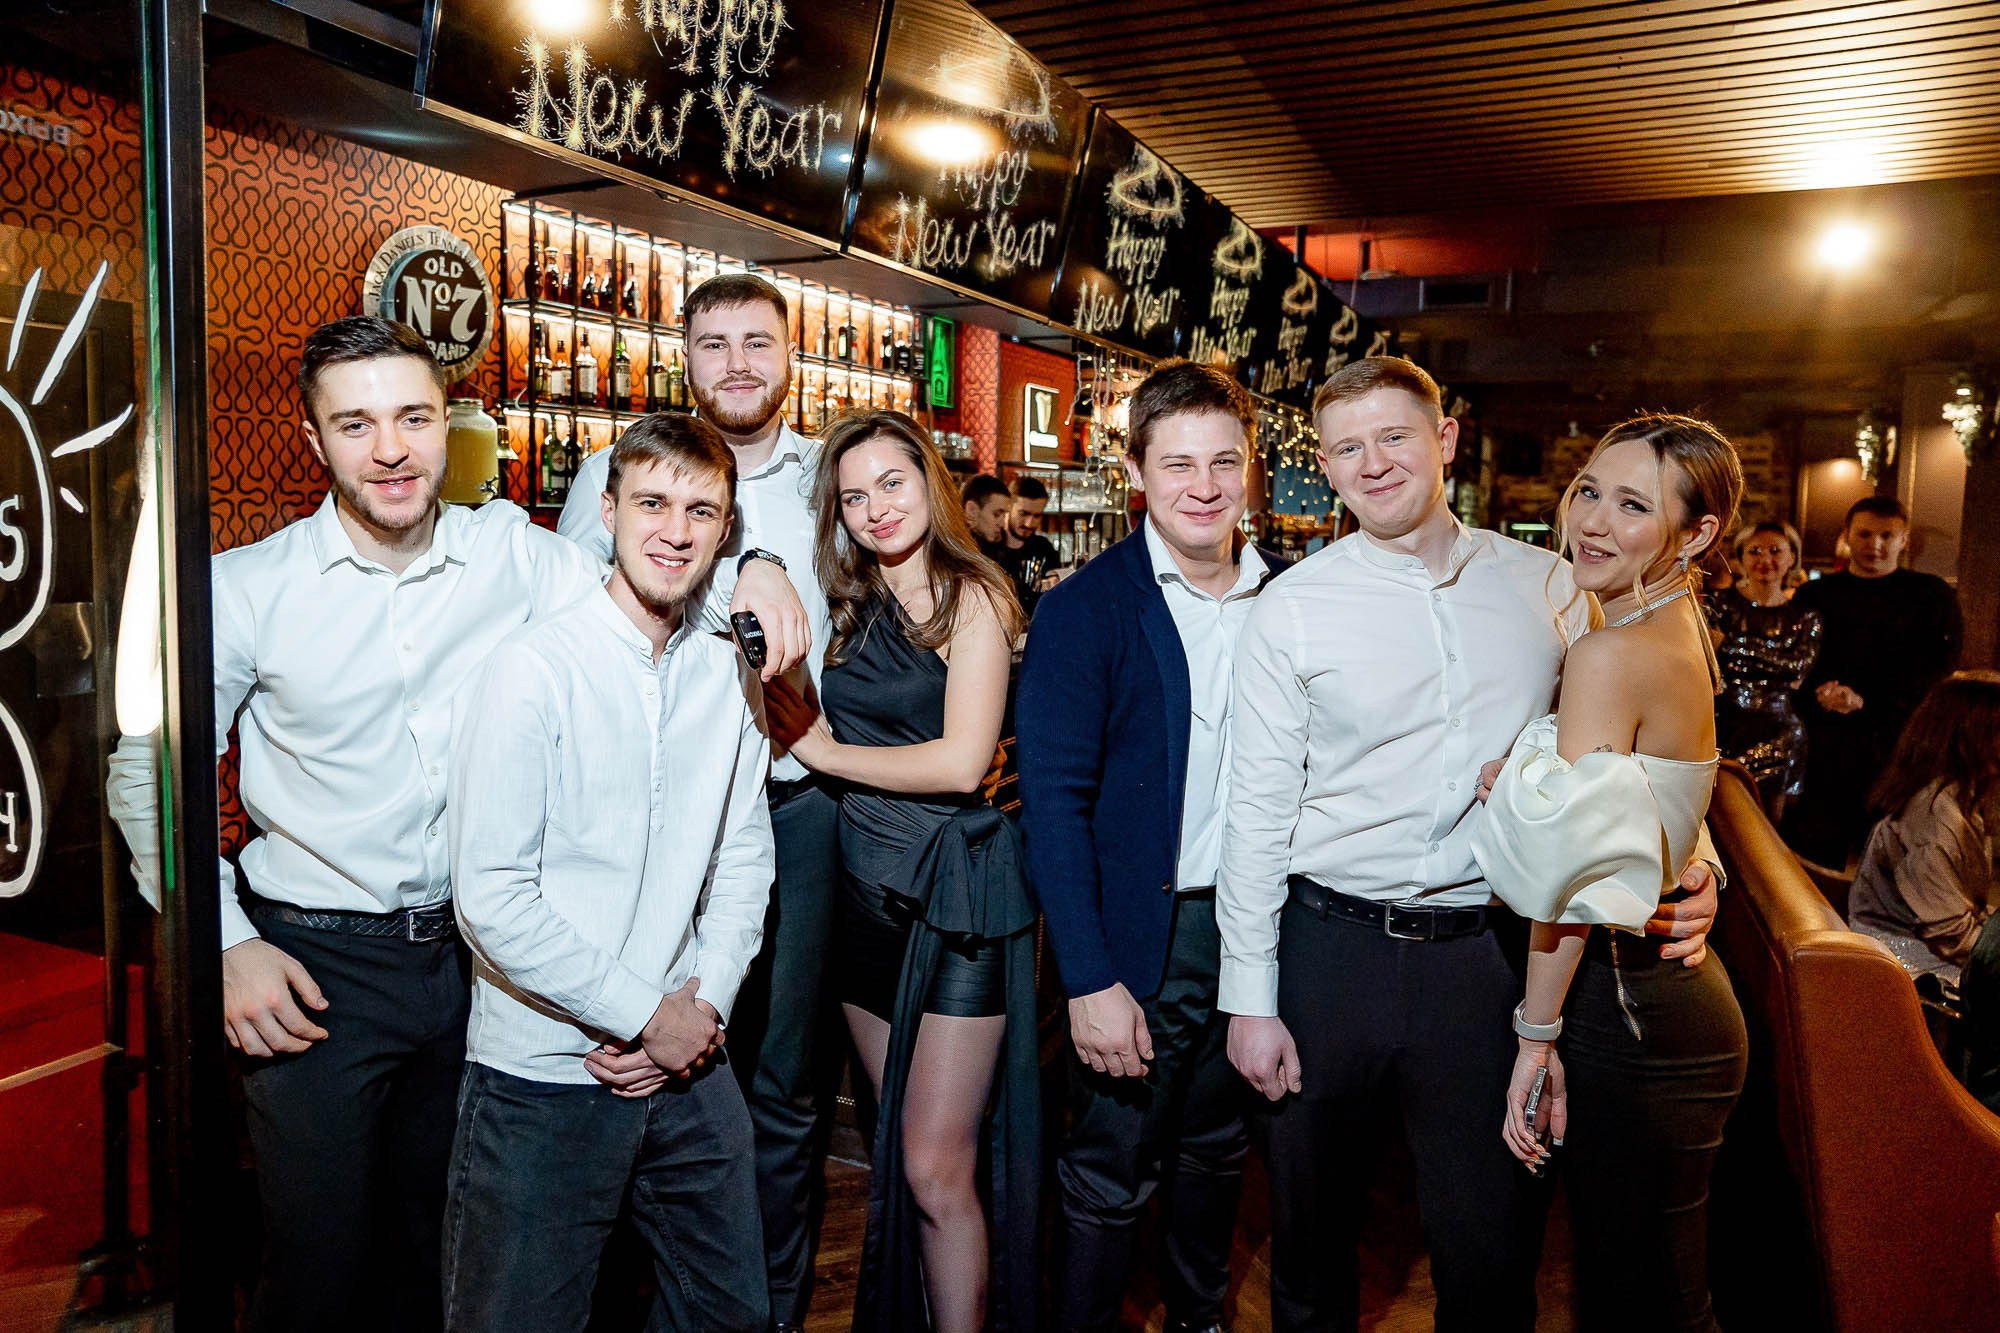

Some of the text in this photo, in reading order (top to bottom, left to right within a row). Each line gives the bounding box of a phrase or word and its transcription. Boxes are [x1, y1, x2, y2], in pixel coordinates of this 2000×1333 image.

[606, 0, 792, 78] appy
[510, 36, 843, 180] New Year
[423, 255, 464, 279] OLD
[890, 194, 1056, 280] New Year
[1106, 217, 1166, 286] Happy
[1074, 278, 1180, 336] New Year
[426, 340, 470, 361] RAND
